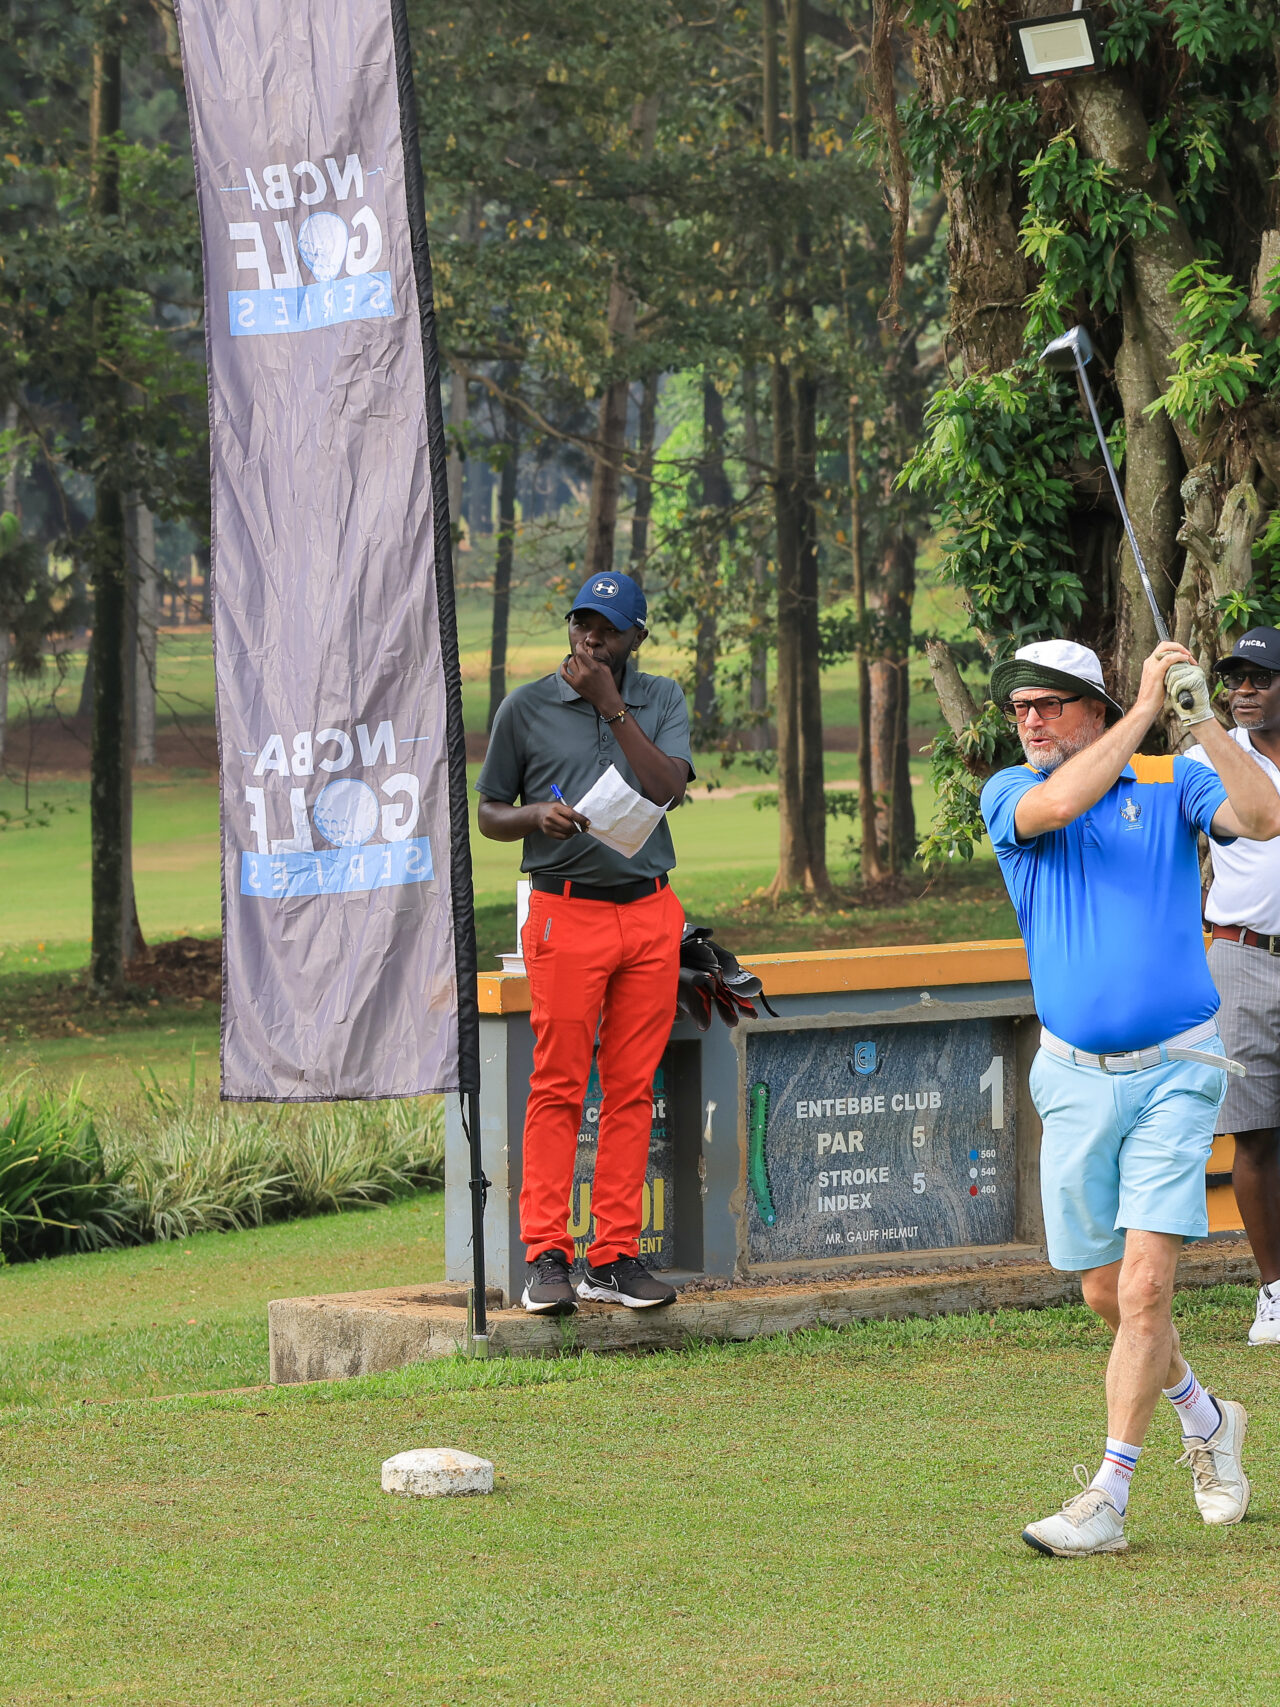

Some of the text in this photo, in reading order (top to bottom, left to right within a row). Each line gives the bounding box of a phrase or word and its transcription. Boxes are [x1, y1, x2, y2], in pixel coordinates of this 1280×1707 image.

[1245, 639, 1267, 649] NCBA
[979, 1055, 1004, 1130] 1
[796, 1091, 942, 1119] ENTEBBE CLUB
[817, 1125, 926, 1155] PAR 5
[980, 1149, 997, 1159] 560
[818, 1166, 926, 1194] STROKE 5
[980, 1167, 997, 1177] 540
[980, 1185, 997, 1195] 460
[818, 1192, 872, 1213] INDEX
[825, 1226, 919, 1245] MR. GAUFF HELMUT
